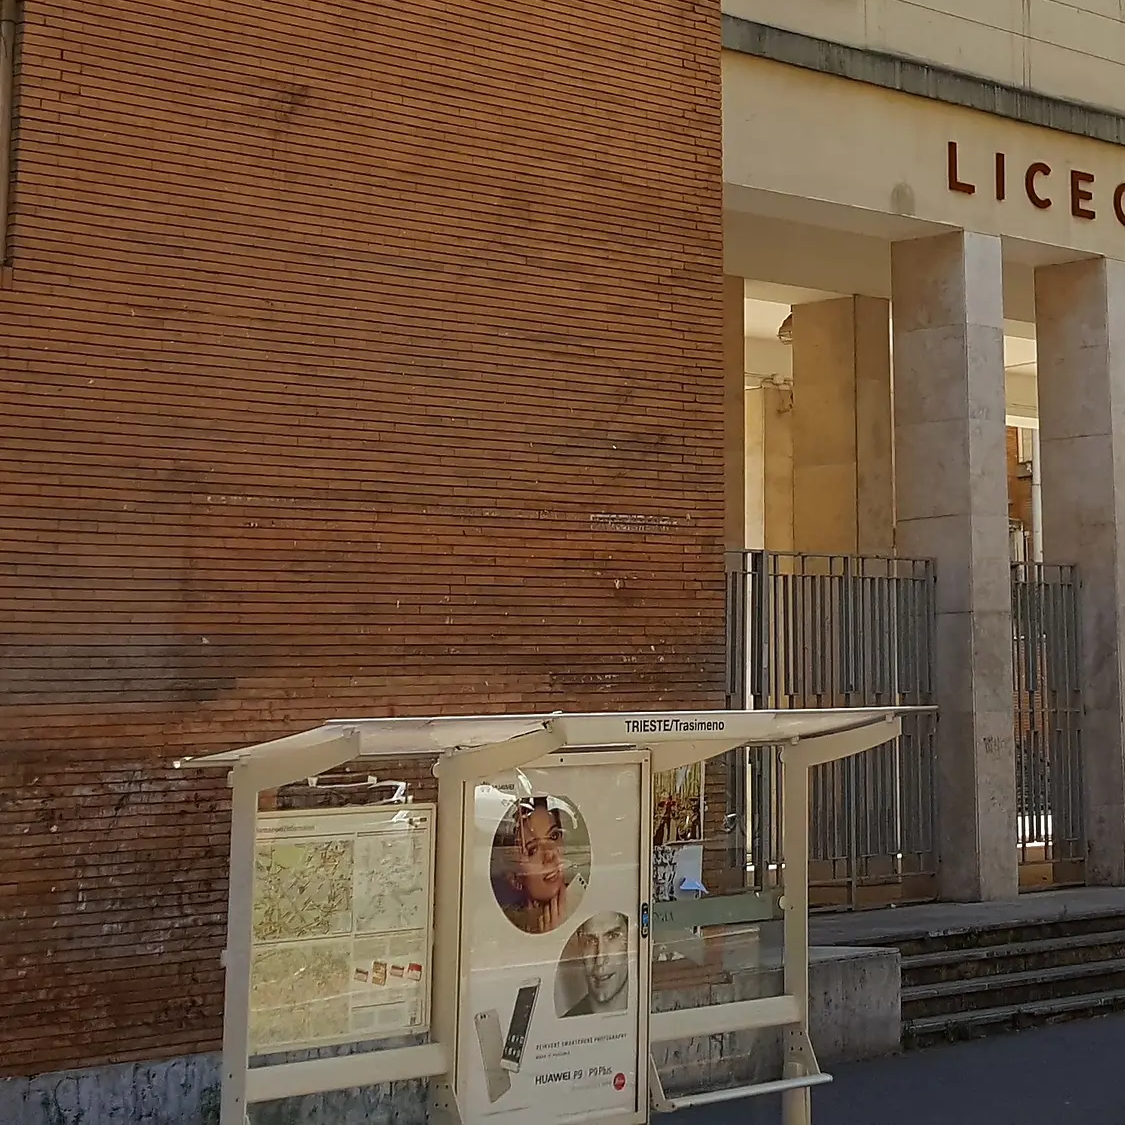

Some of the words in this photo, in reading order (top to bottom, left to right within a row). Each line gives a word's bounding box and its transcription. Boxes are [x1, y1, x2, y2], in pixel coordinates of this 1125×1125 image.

[625, 719, 725, 733] TRIESTE/Trasimeno
[535, 1071, 571, 1085] HUAWEI
[573, 1070, 583, 1080] P9
[588, 1068, 598, 1077] P9
